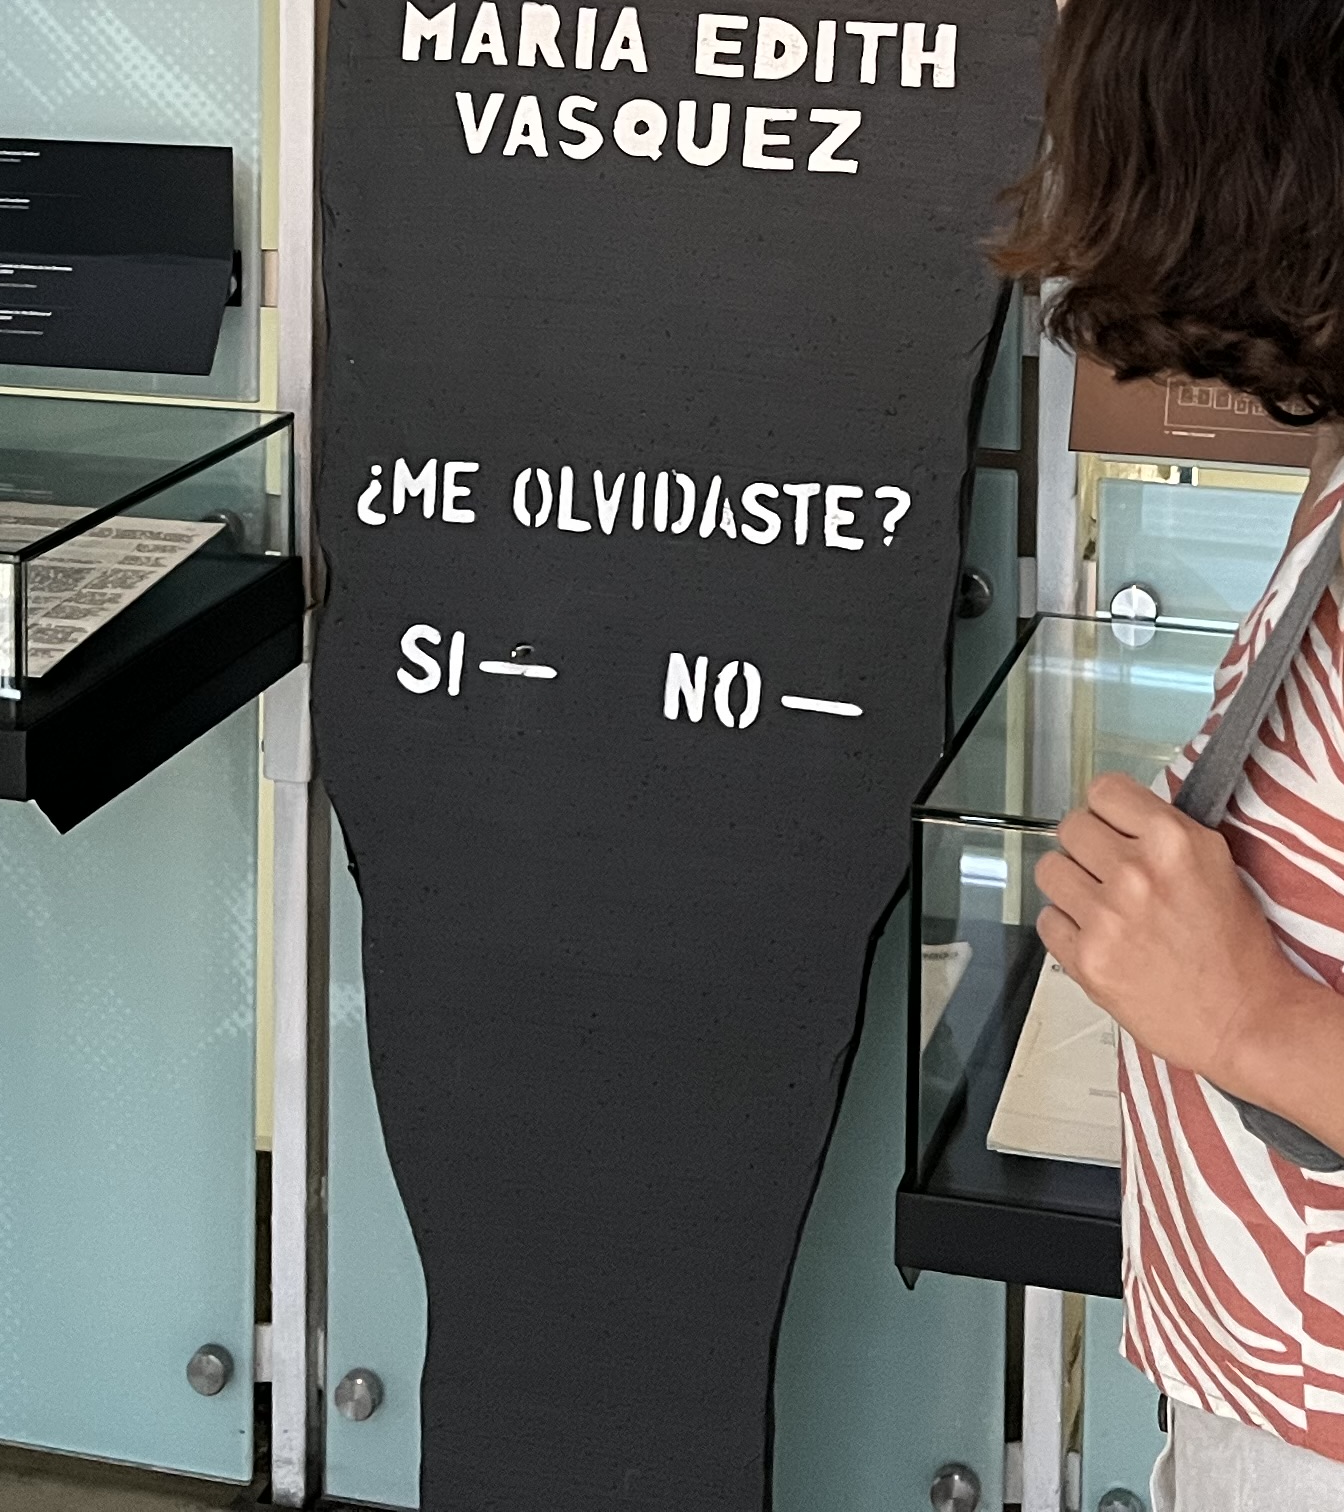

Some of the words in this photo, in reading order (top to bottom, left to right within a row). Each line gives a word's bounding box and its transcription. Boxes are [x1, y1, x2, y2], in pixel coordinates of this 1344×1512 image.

[401, 1, 648, 72] MARIA
[695, 13, 957, 89] EDITH
[455, 91, 862, 174] VASQUEZ
[358, 458, 480, 526] ¿ME
[513, 466, 911, 551] OLVIDASTE?
